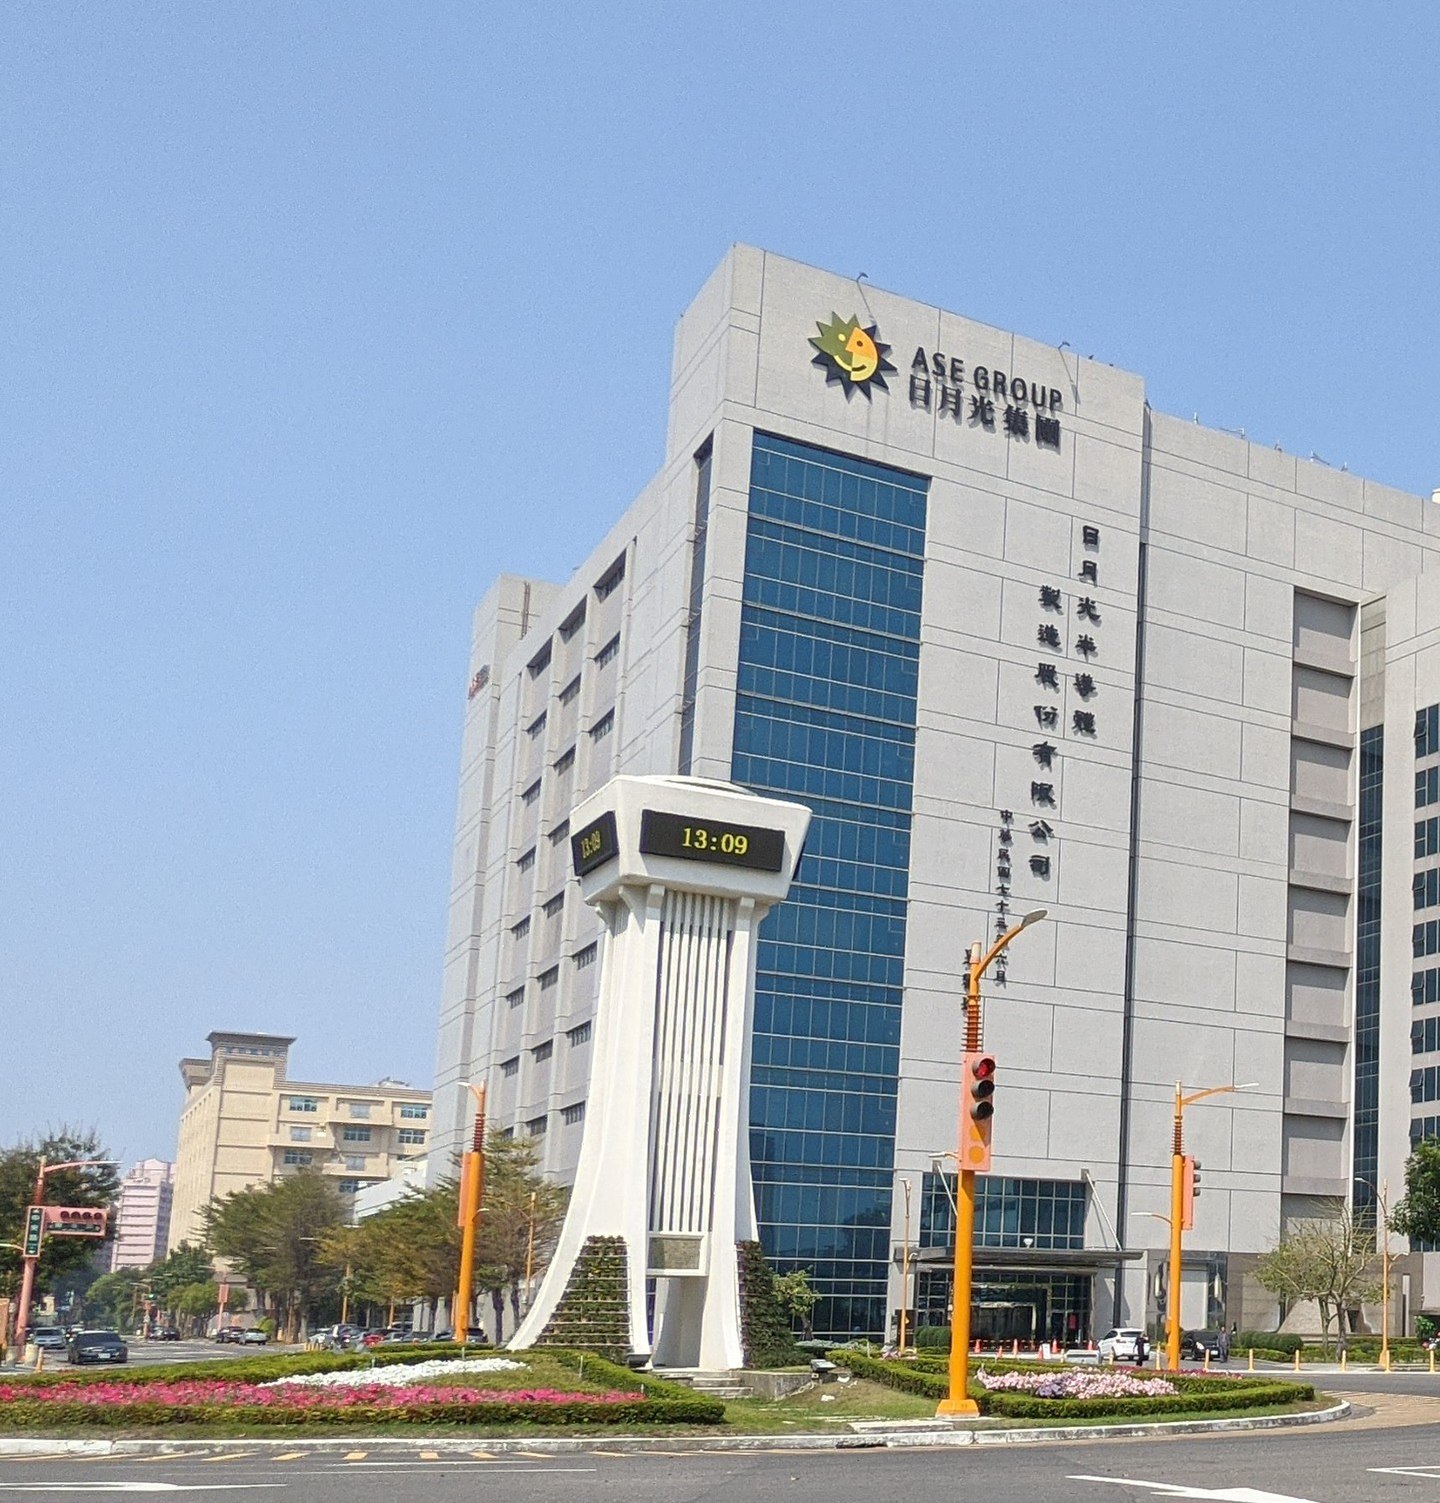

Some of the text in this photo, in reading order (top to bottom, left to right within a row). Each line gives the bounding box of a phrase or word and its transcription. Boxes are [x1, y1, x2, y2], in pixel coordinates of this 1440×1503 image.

[909, 374, 1060, 447] 日月光集團
[911, 346, 1062, 411] ASE GROUP
[1028, 585, 1061, 876] 製造股份有限公司
[682, 827, 748, 855] 13:09
